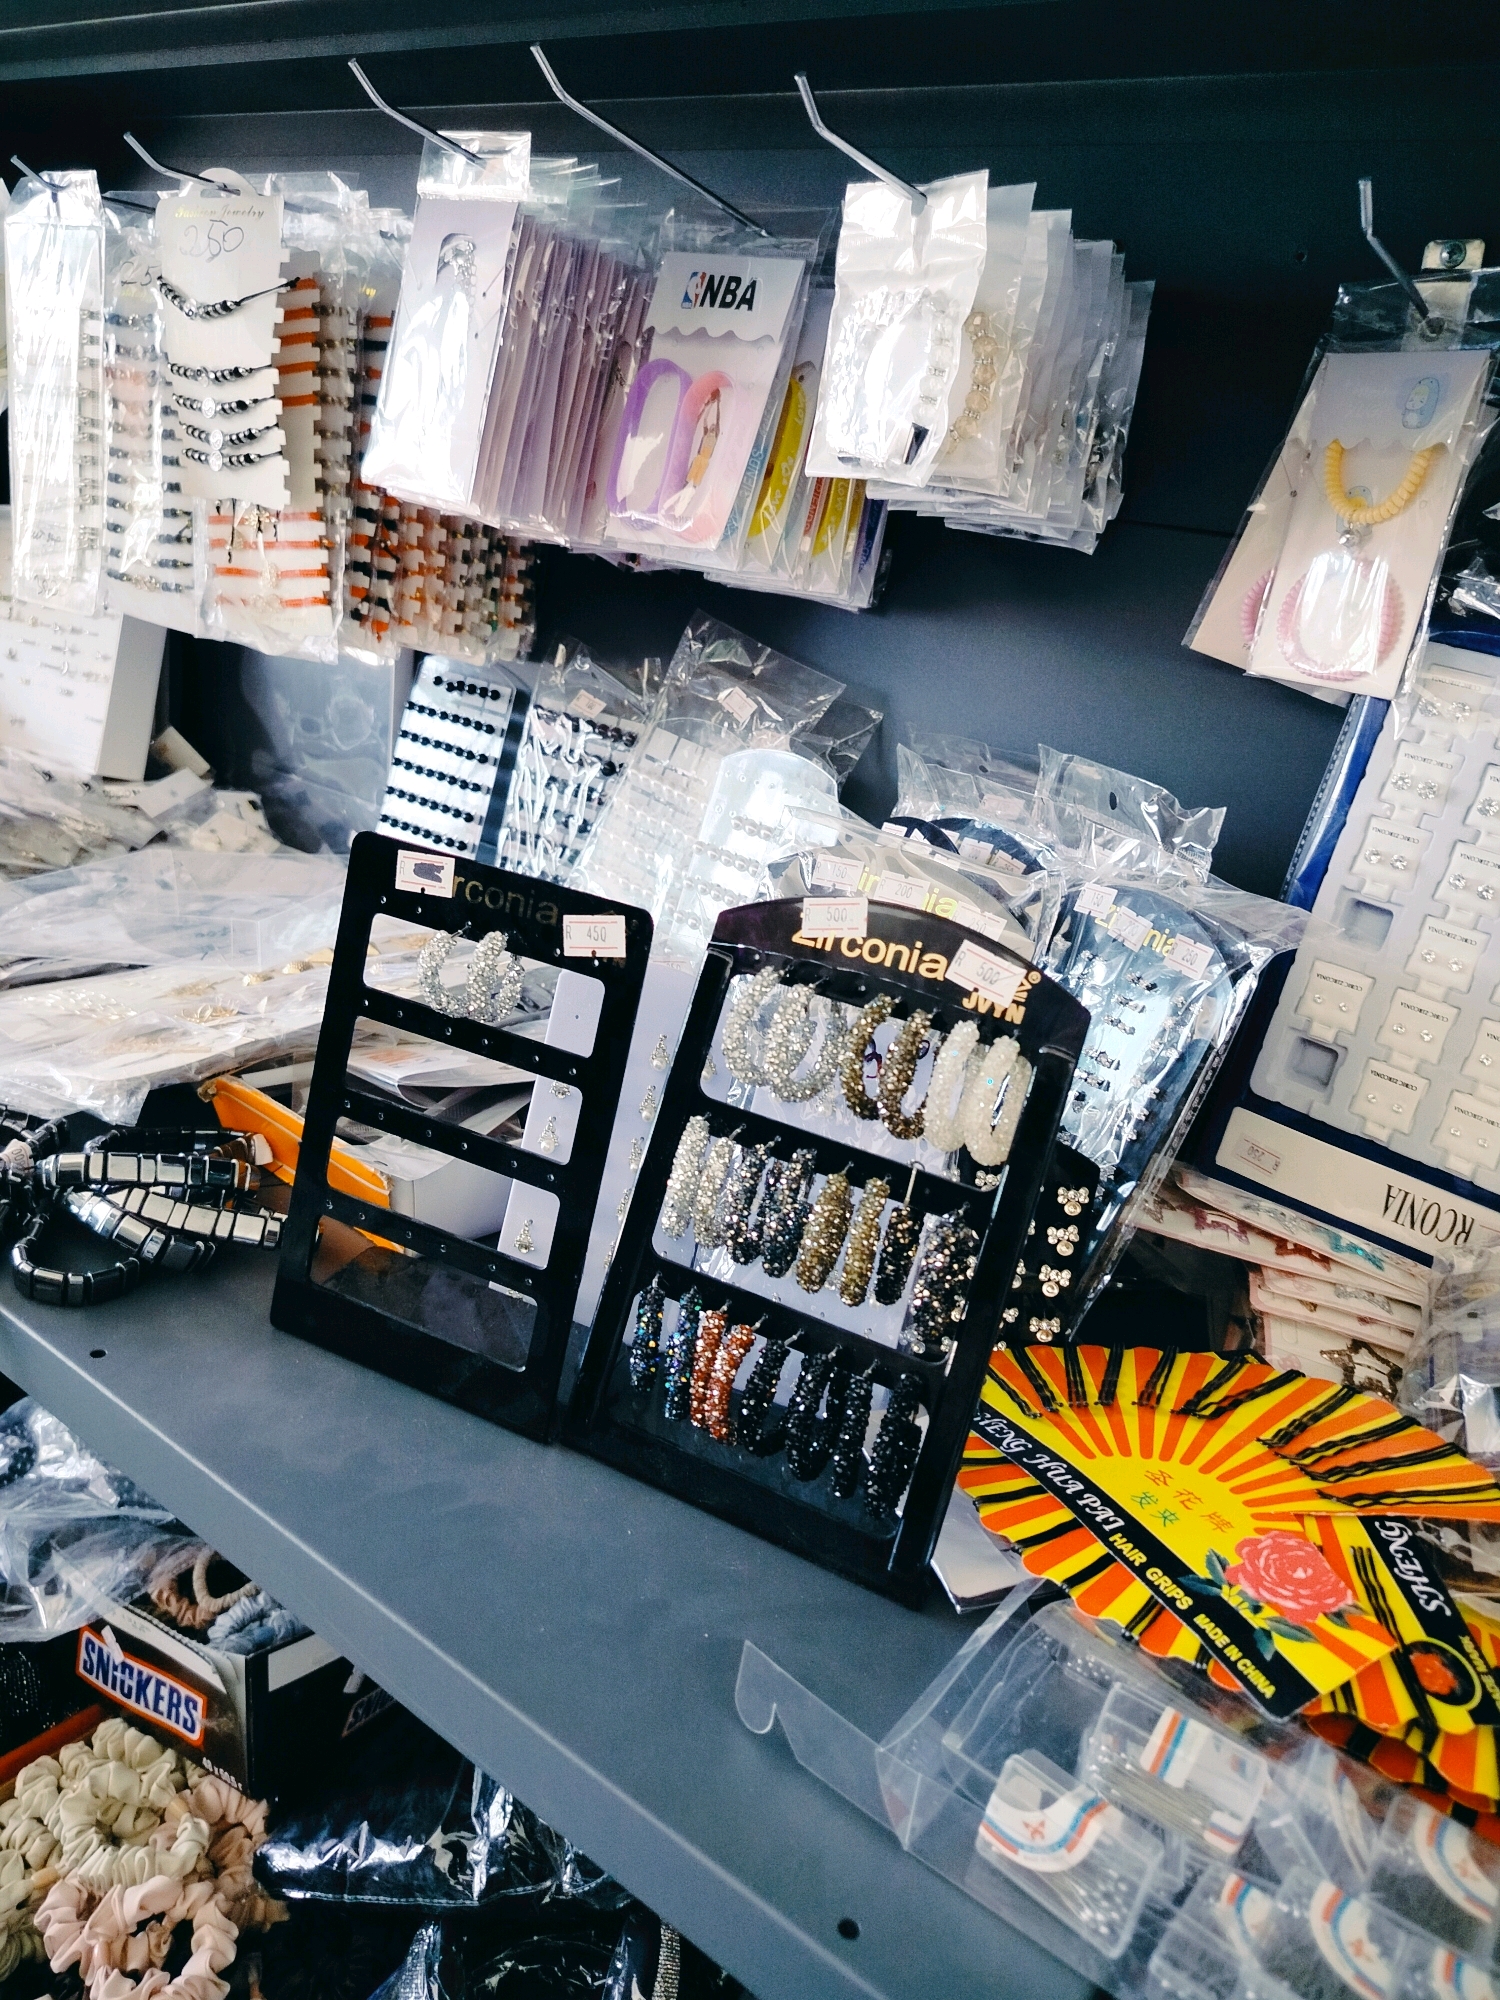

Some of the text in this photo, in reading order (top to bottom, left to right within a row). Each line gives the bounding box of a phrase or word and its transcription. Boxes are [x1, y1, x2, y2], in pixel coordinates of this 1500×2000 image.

[219, 204, 265, 220] Jewelry
[179, 219, 245, 262] 250
[700, 274, 757, 312] NBA
[831, 864, 847, 879] 150
[453, 875, 558, 927] rconia
[894, 883, 913, 899] 200
[826, 907, 848, 922] 500
[586, 926, 607, 942] 450
[976, 962, 1001, 985] 500
[1247, 1146, 1265, 1162] 250
[1382, 1183, 1475, 1246] RCONIA
[1130, 1491, 1180, 1527] 发夹
[973, 1413, 1276, 1699] HENG HUA PAI HAIR GRIPS MADE IN CHINA
[1375, 1520, 1452, 1617] SHENG
[83, 1636, 199, 1735] SNICKERS
